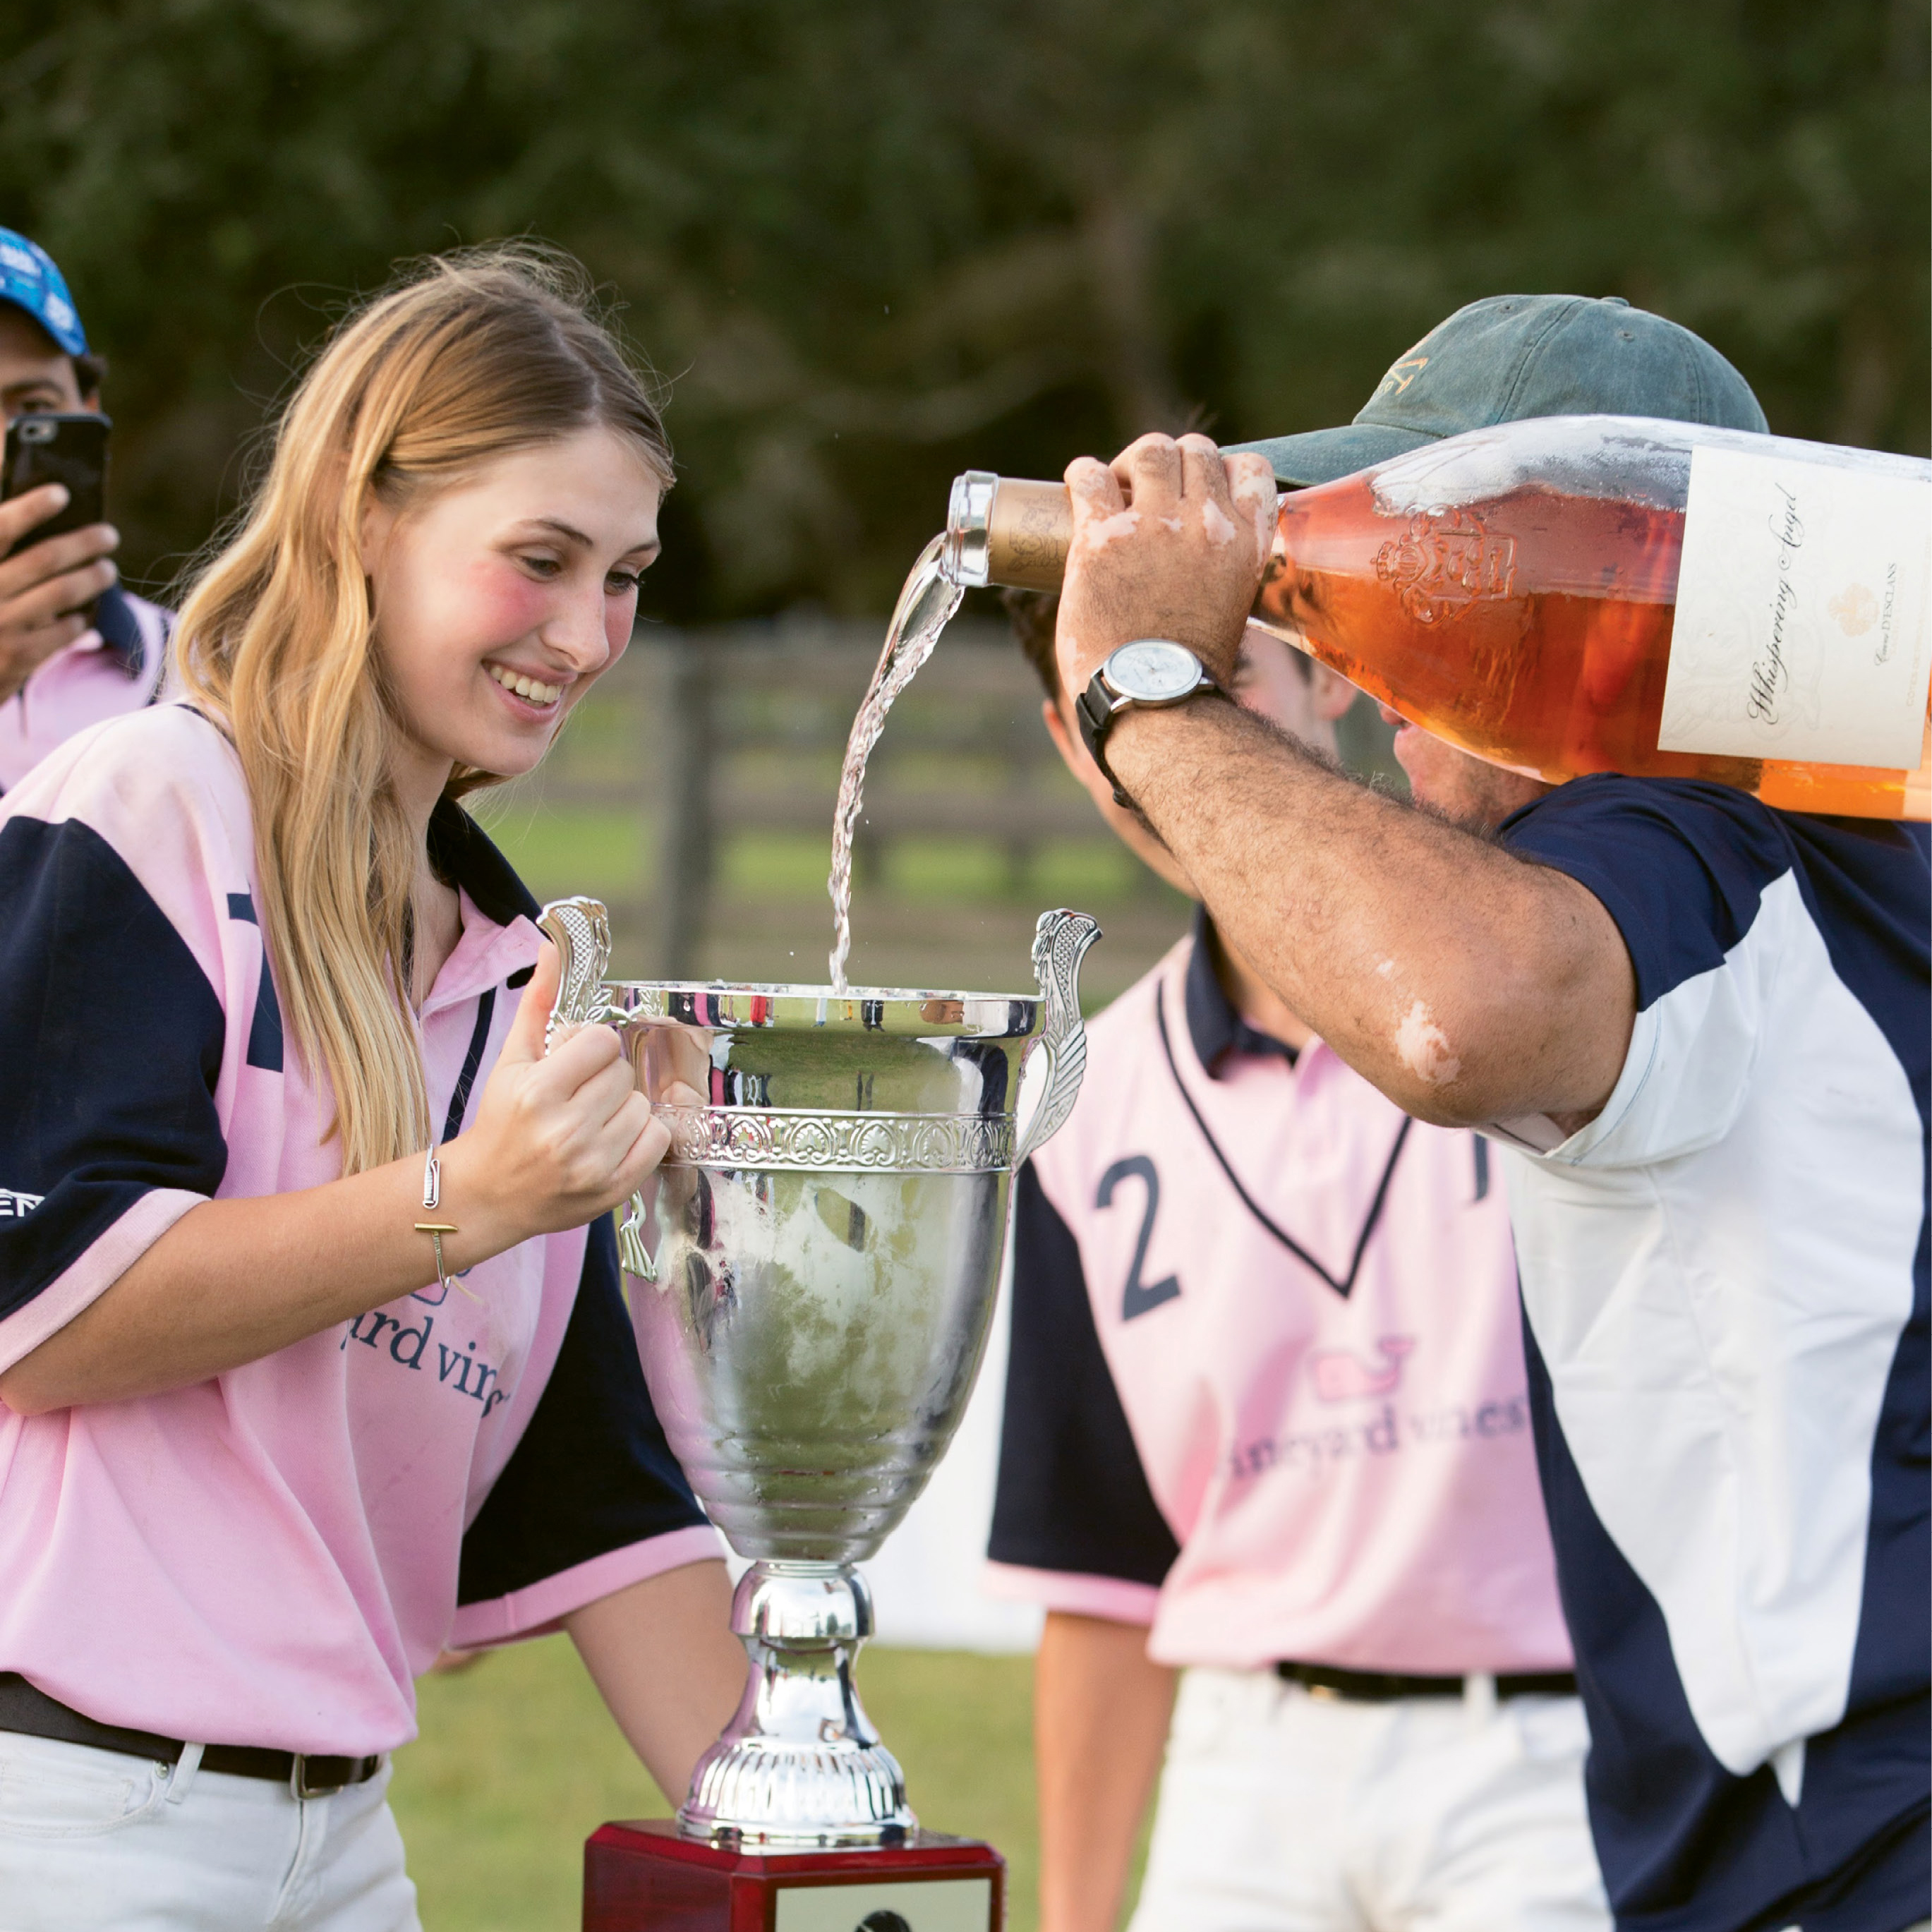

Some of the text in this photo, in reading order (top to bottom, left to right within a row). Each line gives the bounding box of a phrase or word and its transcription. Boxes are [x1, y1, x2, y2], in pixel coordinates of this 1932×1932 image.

[1746, 483, 1804, 725] Whispering Angel
[1094, 1154, 1182, 1322] 2
